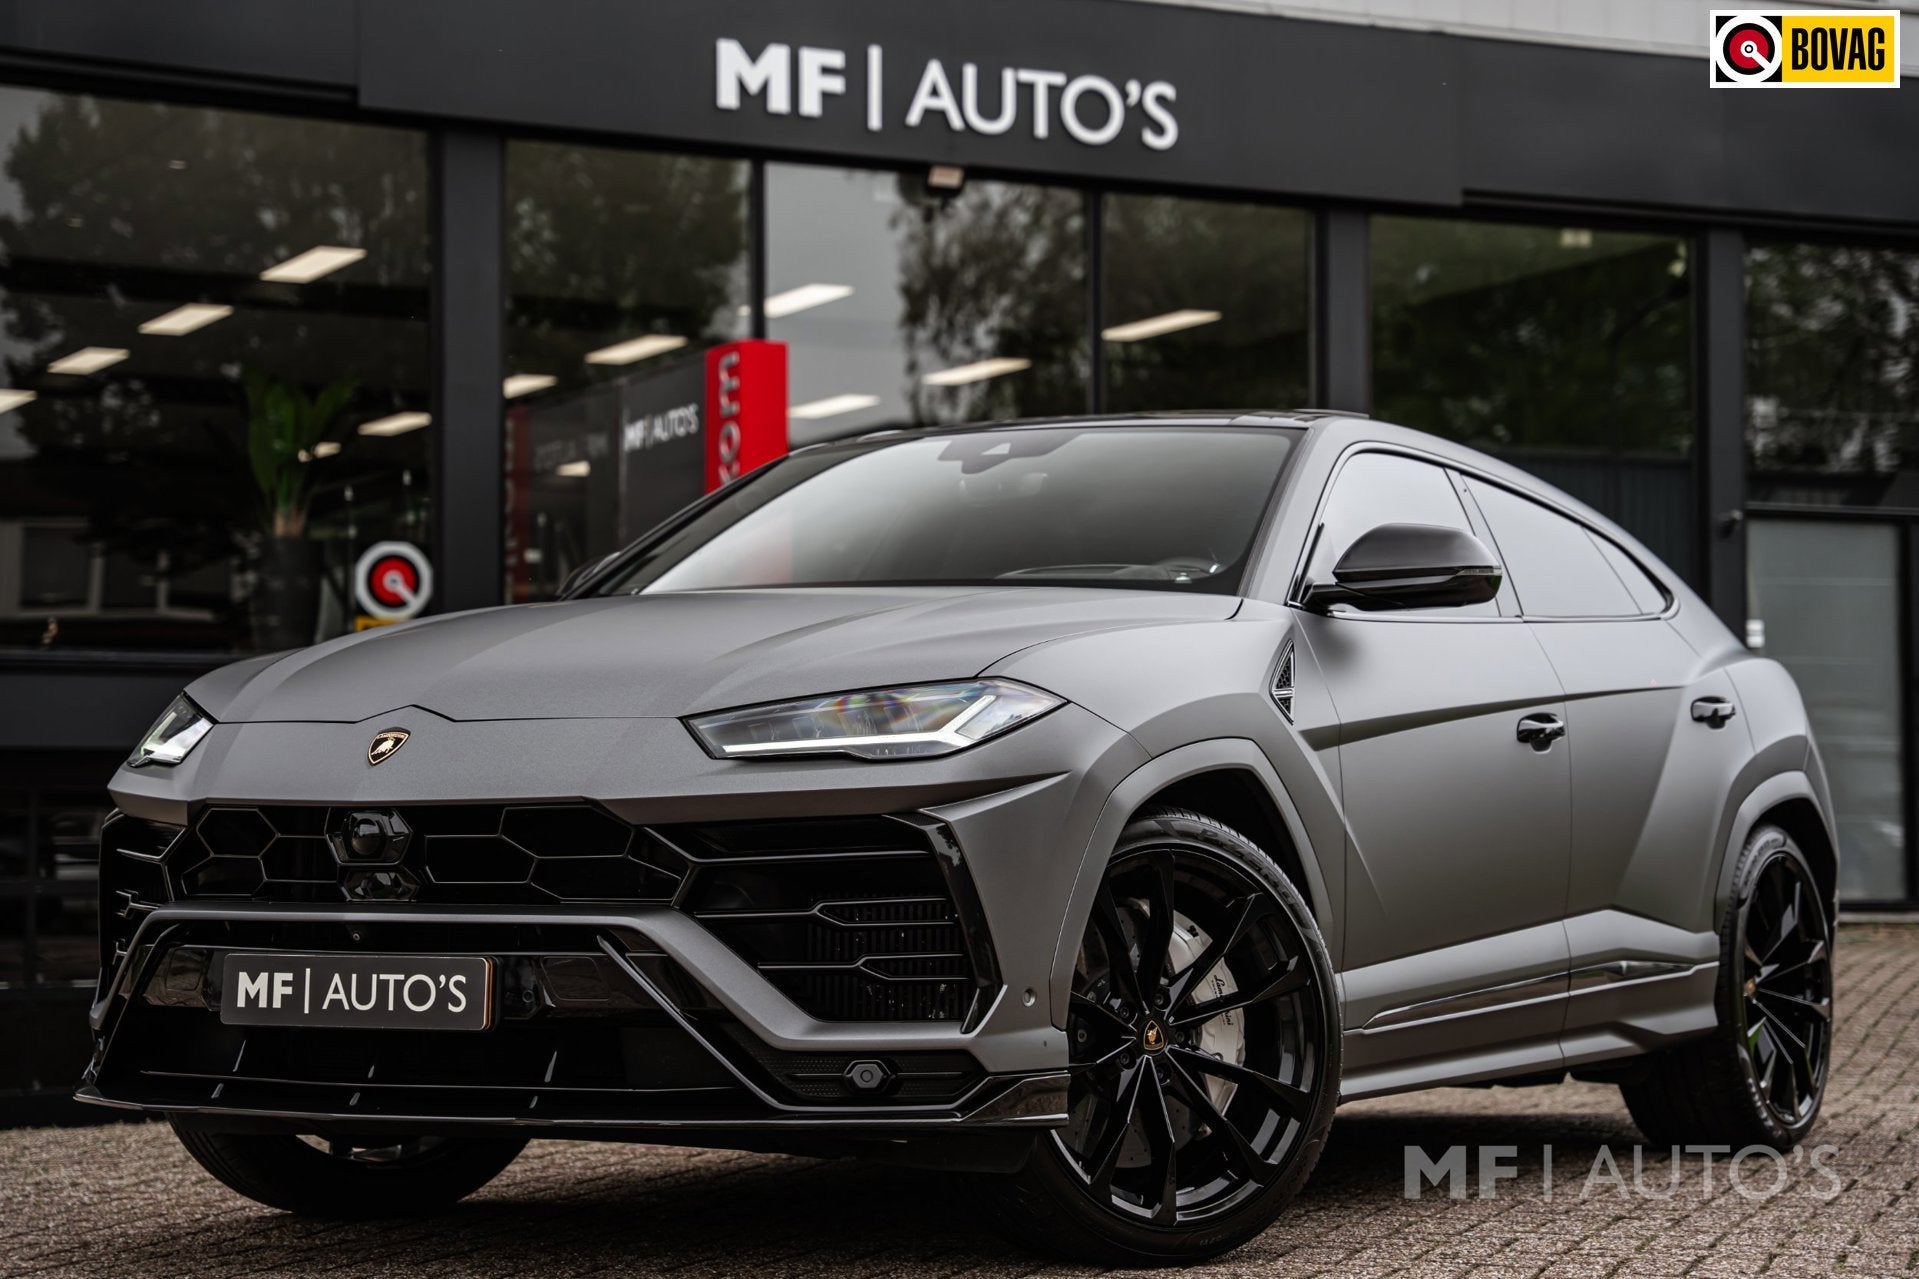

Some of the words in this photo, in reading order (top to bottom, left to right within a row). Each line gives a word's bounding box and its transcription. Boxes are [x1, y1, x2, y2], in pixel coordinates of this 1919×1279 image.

[716, 38, 846, 117] MF
[905, 59, 1179, 150] AUTO'S
[236, 971, 294, 1009] MF
[321, 973, 467, 1013] AUTO'S
